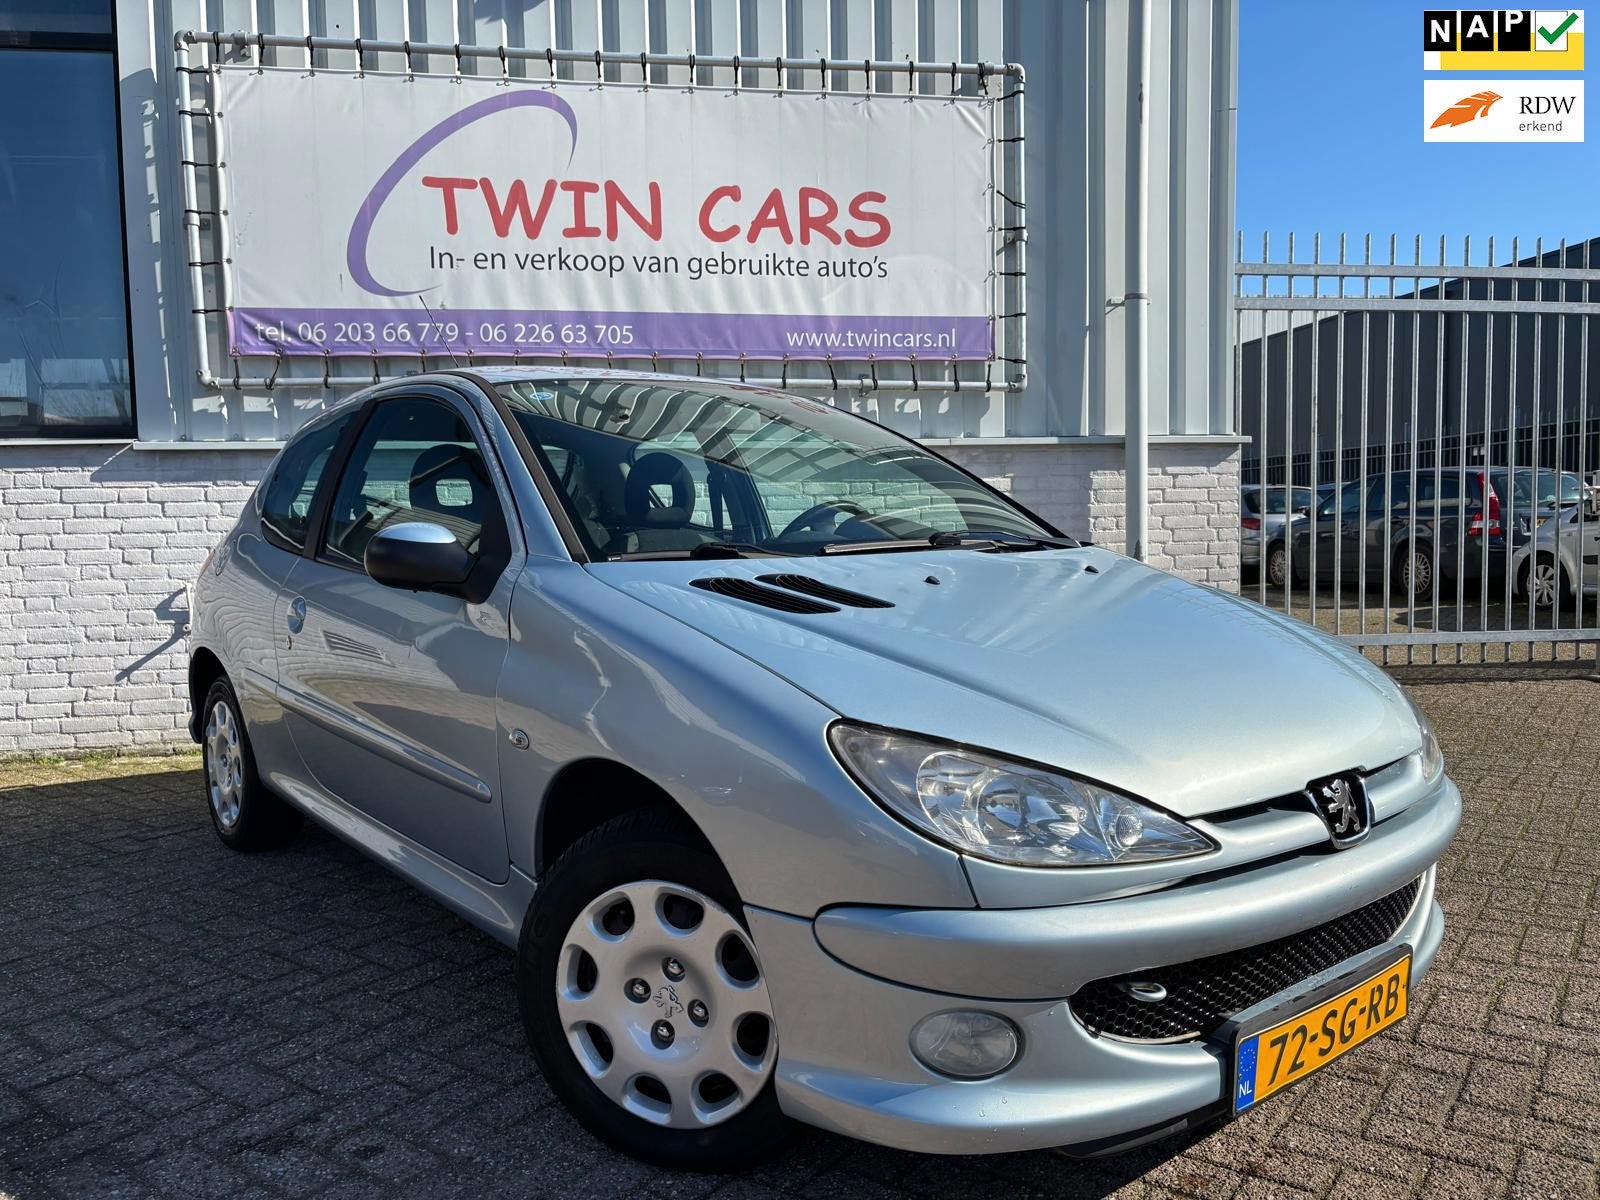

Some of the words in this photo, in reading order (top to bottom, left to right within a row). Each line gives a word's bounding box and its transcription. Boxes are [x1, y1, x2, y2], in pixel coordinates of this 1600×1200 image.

[421, 175, 663, 242] TWIN
[699, 183, 892, 249] CARS
[429, 246, 466, 270] In-
[473, 252, 506, 271] en
[514, 248, 625, 278] verkoop
[633, 255, 679, 274] van
[687, 251, 810, 281] gebruikte
[817, 255, 889, 279] auto's
[255, 320, 292, 343] tel.
[298, 322, 328, 343] 06
[334, 322, 376, 343] 203
[382, 322, 411, 343] 66
[417, 323, 459, 343] 779
[479, 322, 508, 343] 06
[513, 323, 555, 344] 226
[560, 324, 587, 344] 63
[594, 324, 634, 345] 705
[786, 327, 957, 349] www.twincars.nl
[1267, 973, 1400, 1087] 72-SG-RB
[1238, 1080, 1253, 1099] NL
